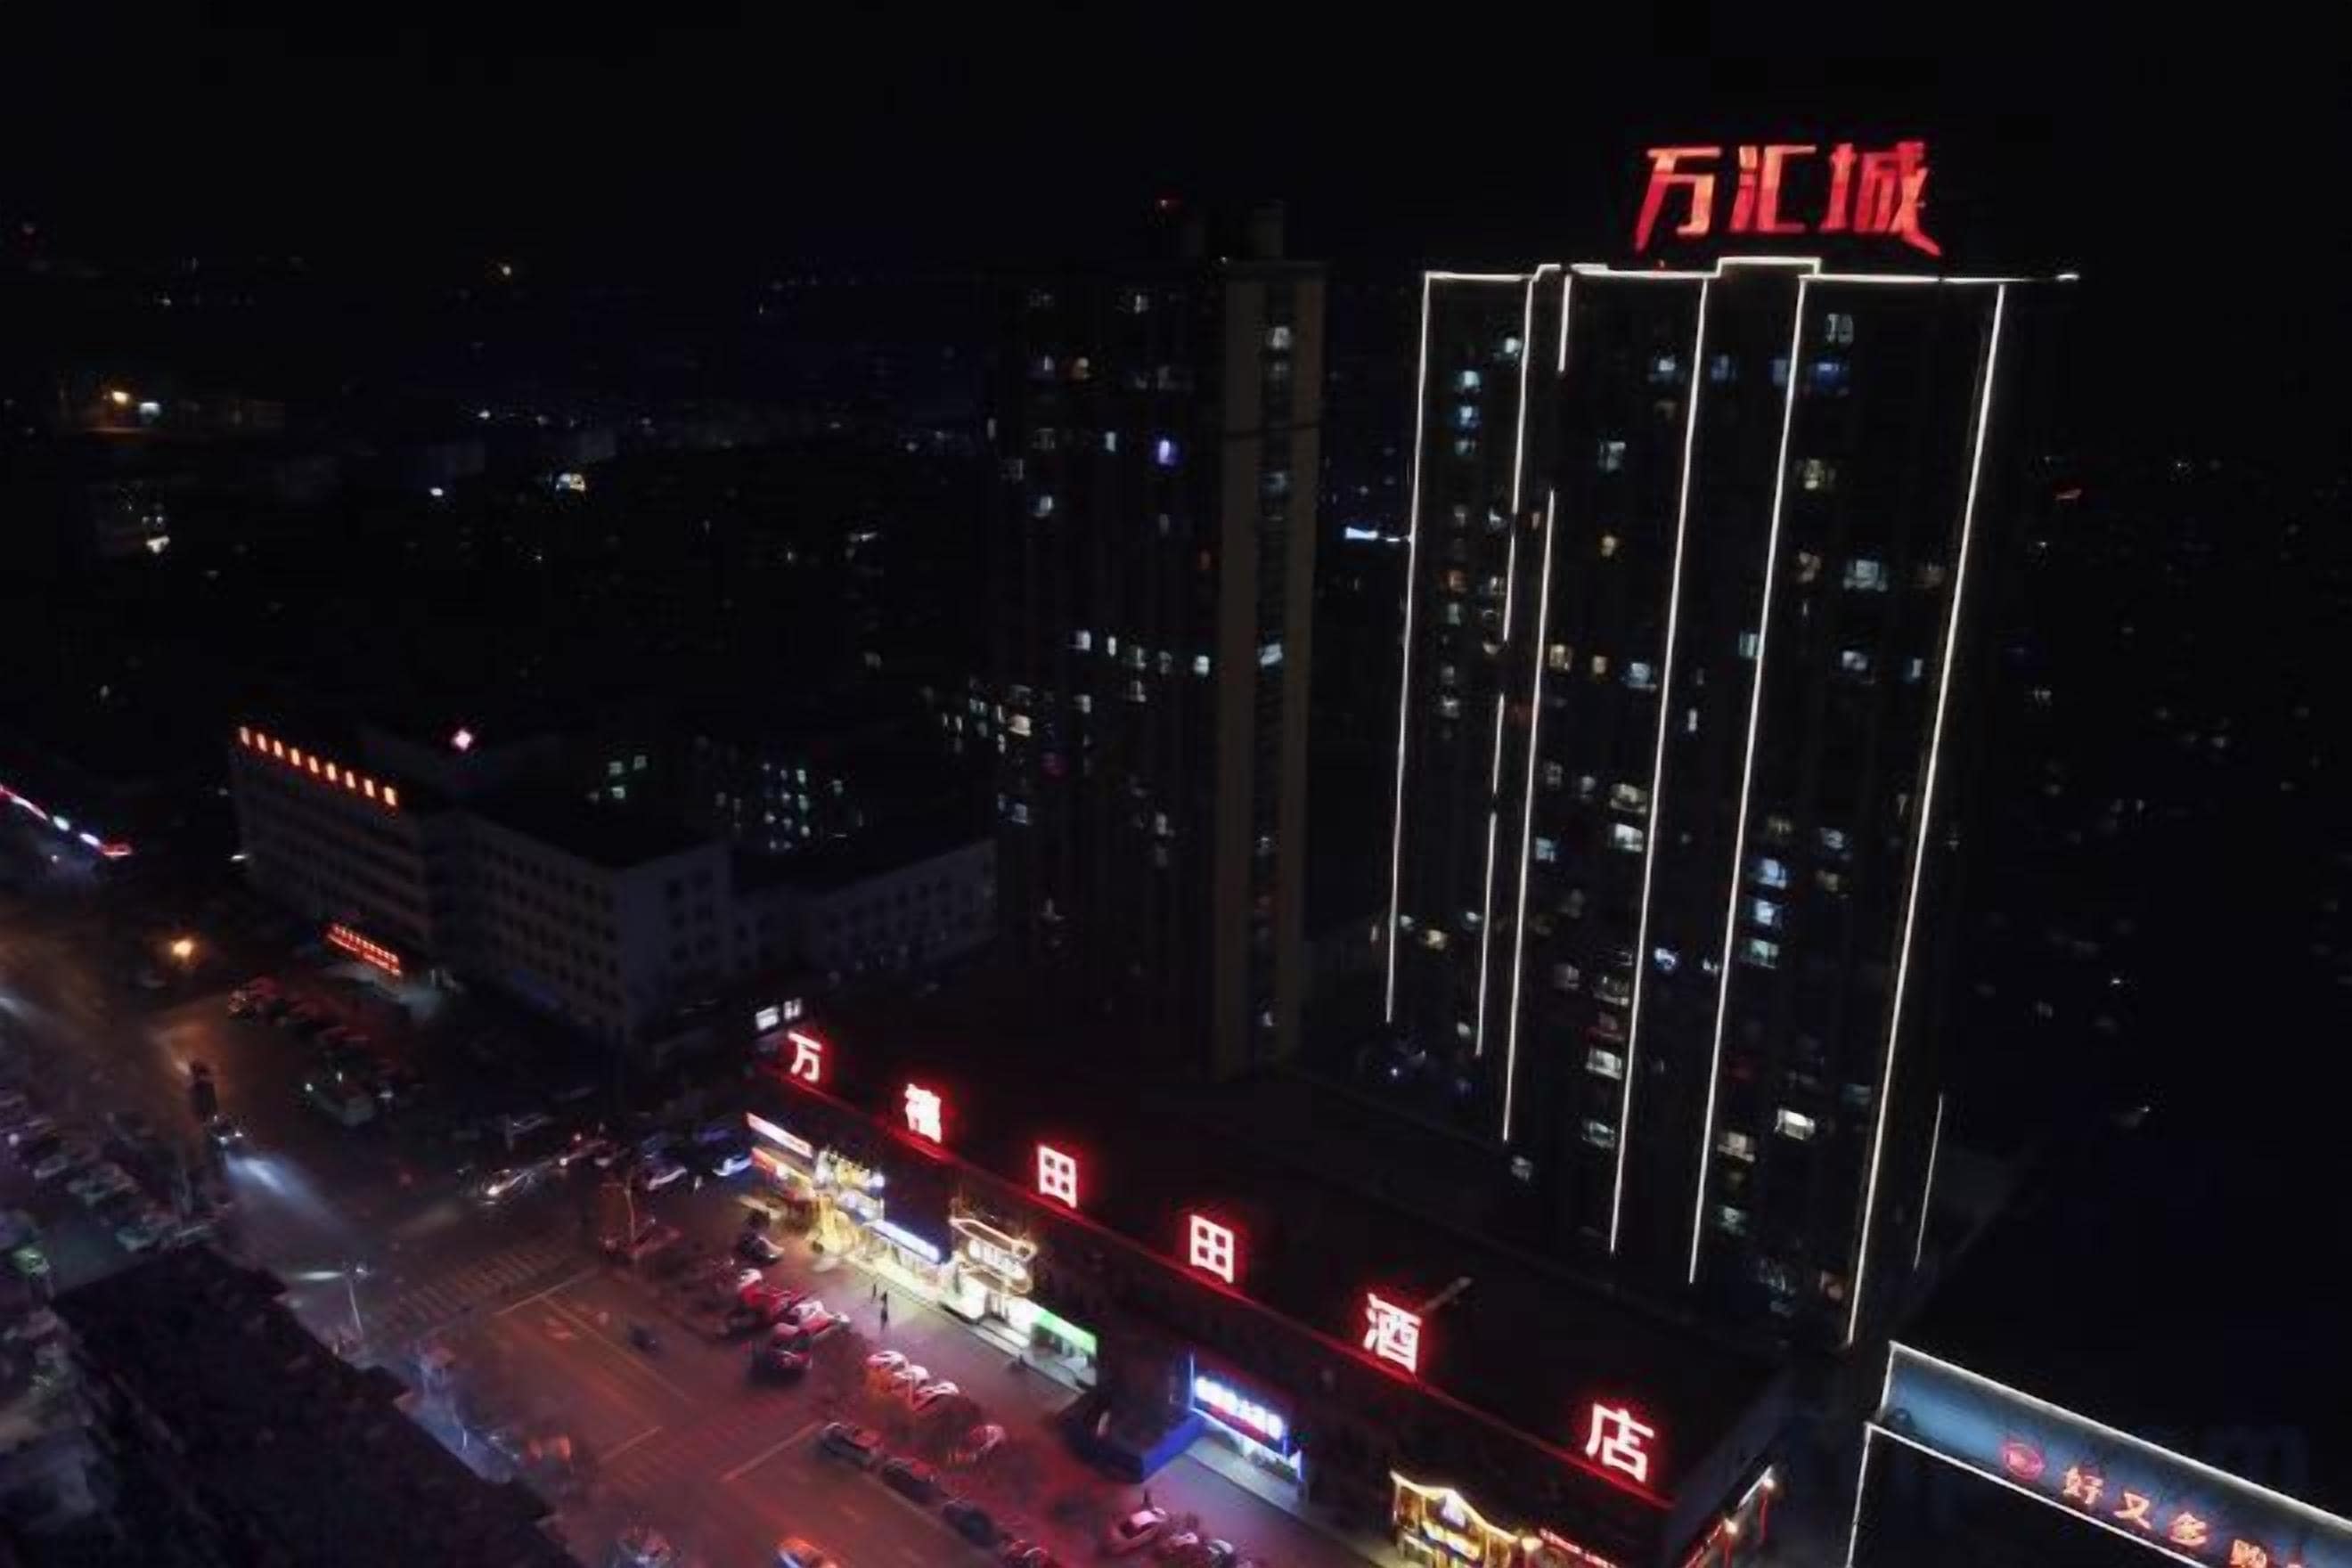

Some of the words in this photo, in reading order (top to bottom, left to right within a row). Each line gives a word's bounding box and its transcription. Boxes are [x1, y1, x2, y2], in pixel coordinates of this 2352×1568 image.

[1635, 141, 1941, 257] 万汇城
[2062, 1466, 2304, 1568] 好又多购
